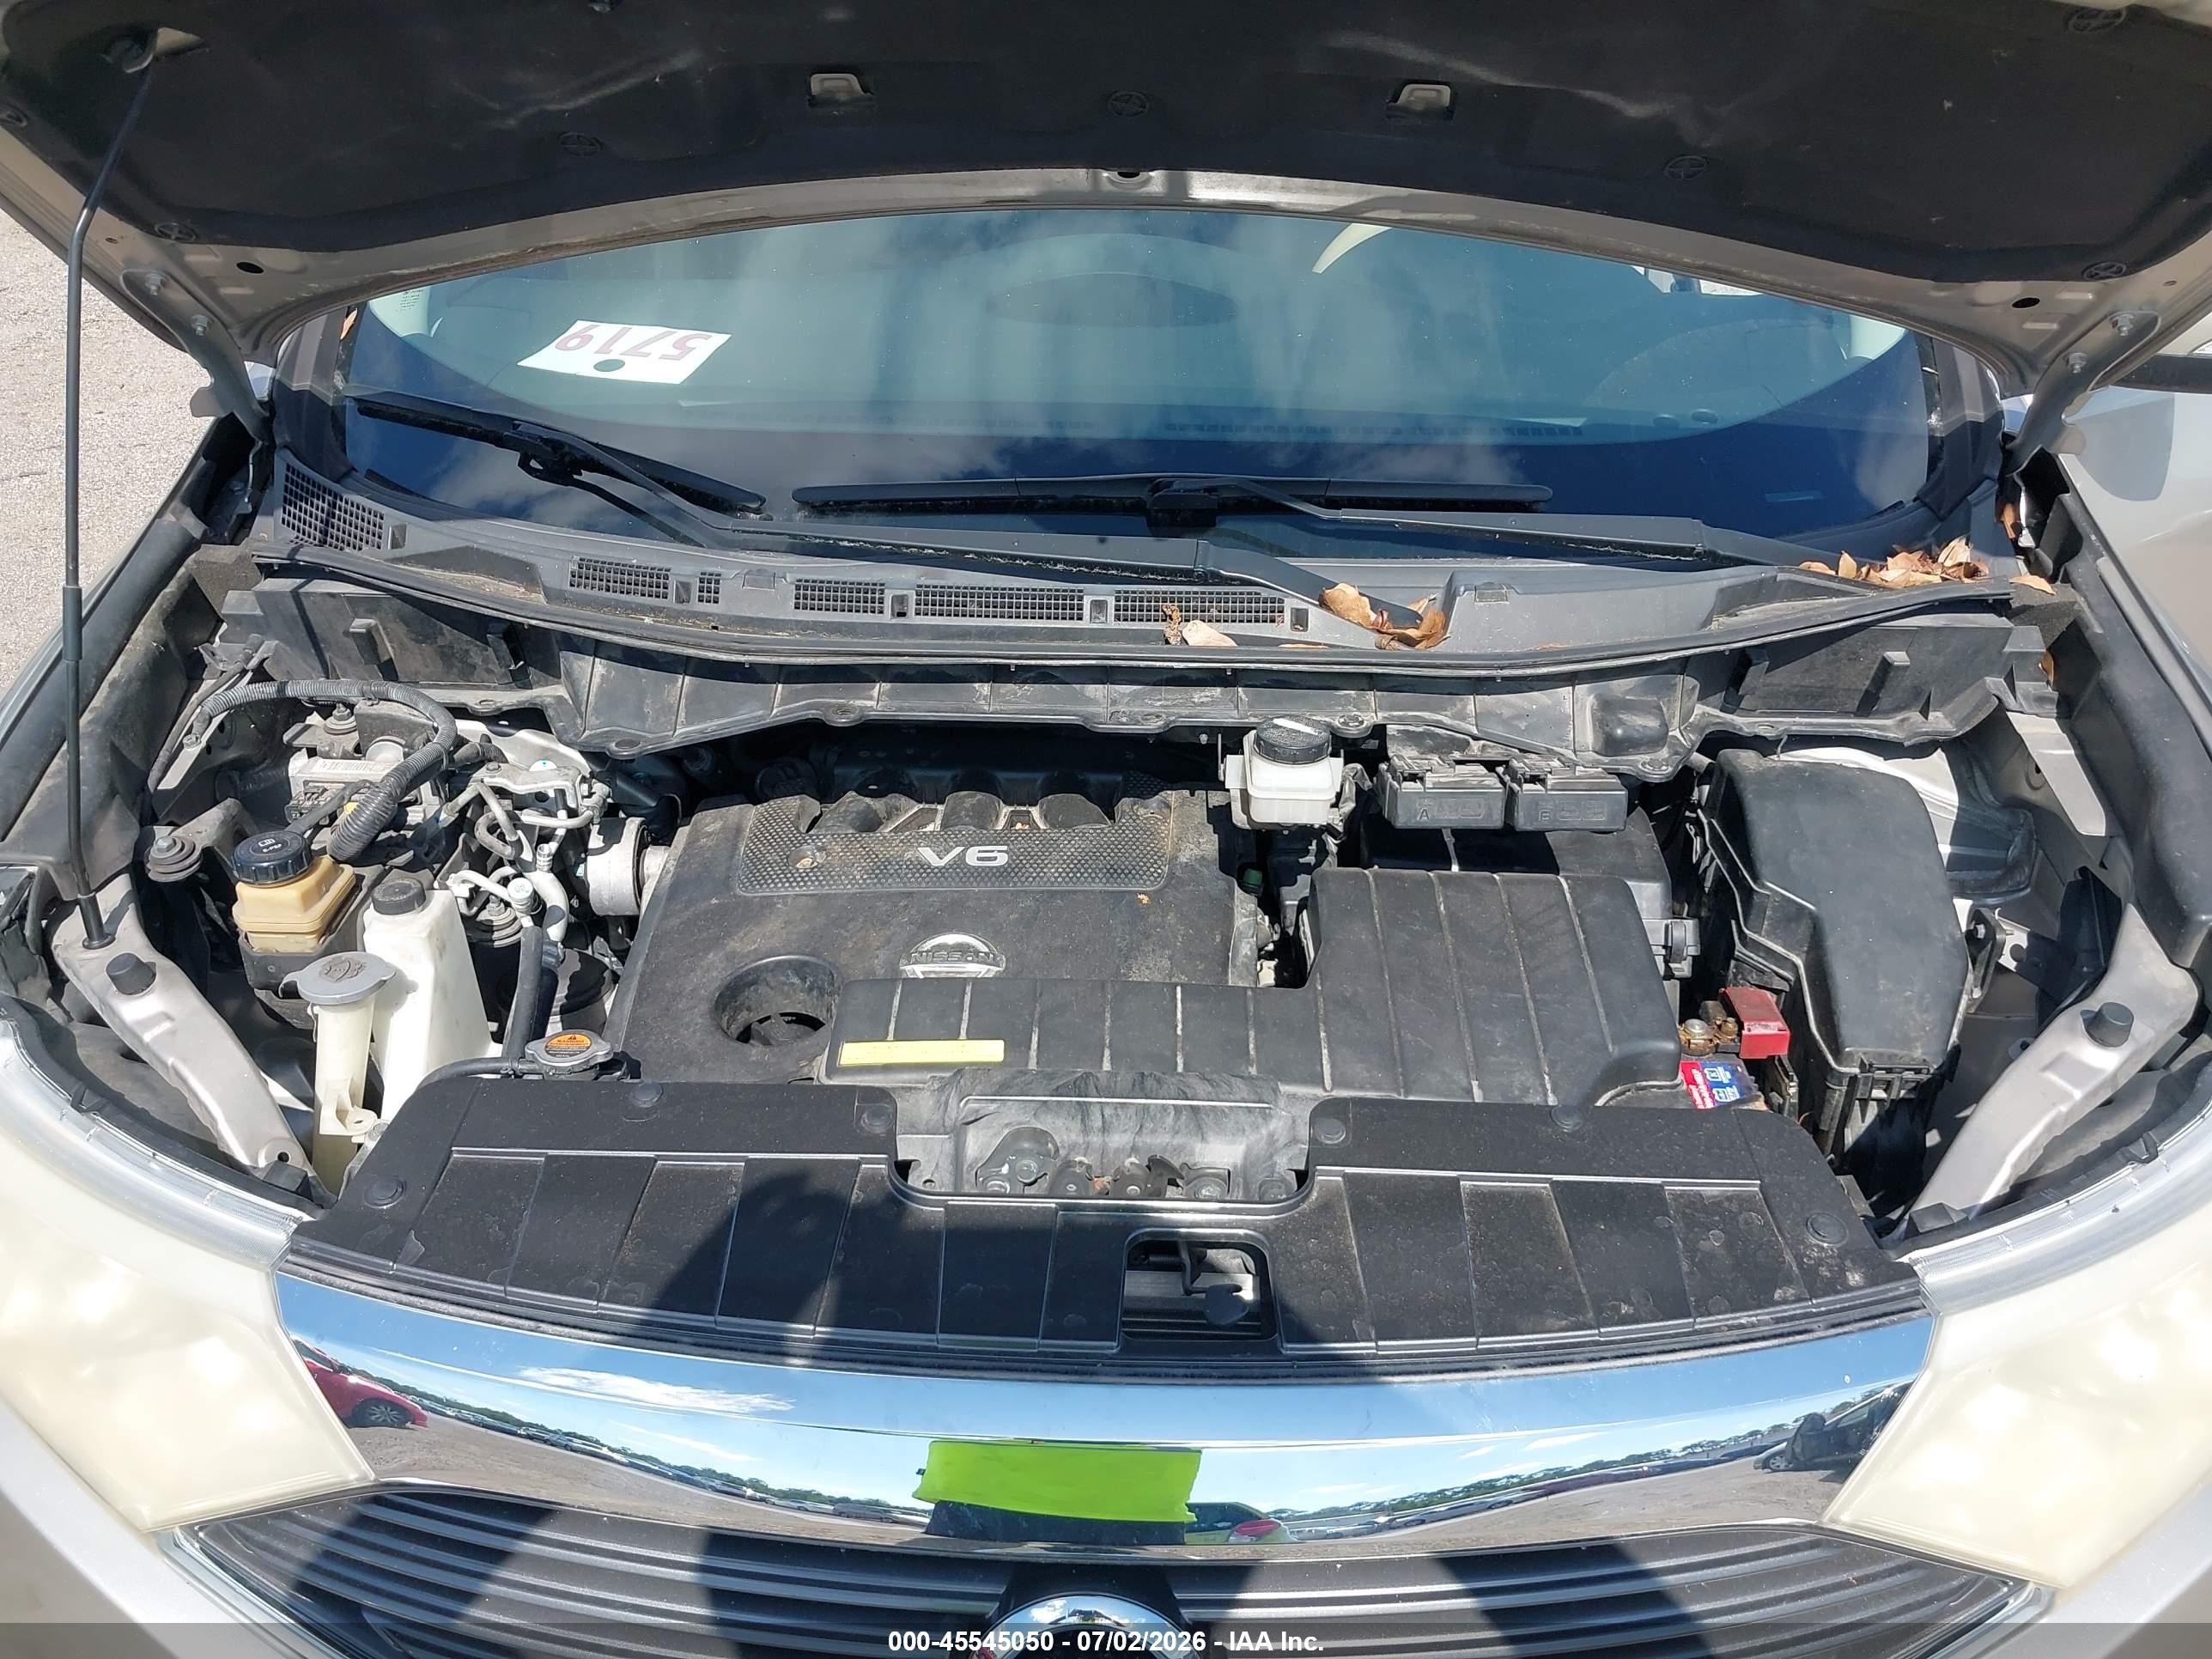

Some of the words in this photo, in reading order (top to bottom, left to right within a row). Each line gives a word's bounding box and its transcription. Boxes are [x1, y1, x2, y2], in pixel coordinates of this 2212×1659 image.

[555, 324, 712, 361] 5719
[1417, 807, 1430, 821] A
[917, 845, 1009, 866] V6
[910, 951, 995, 963] NISSAN
